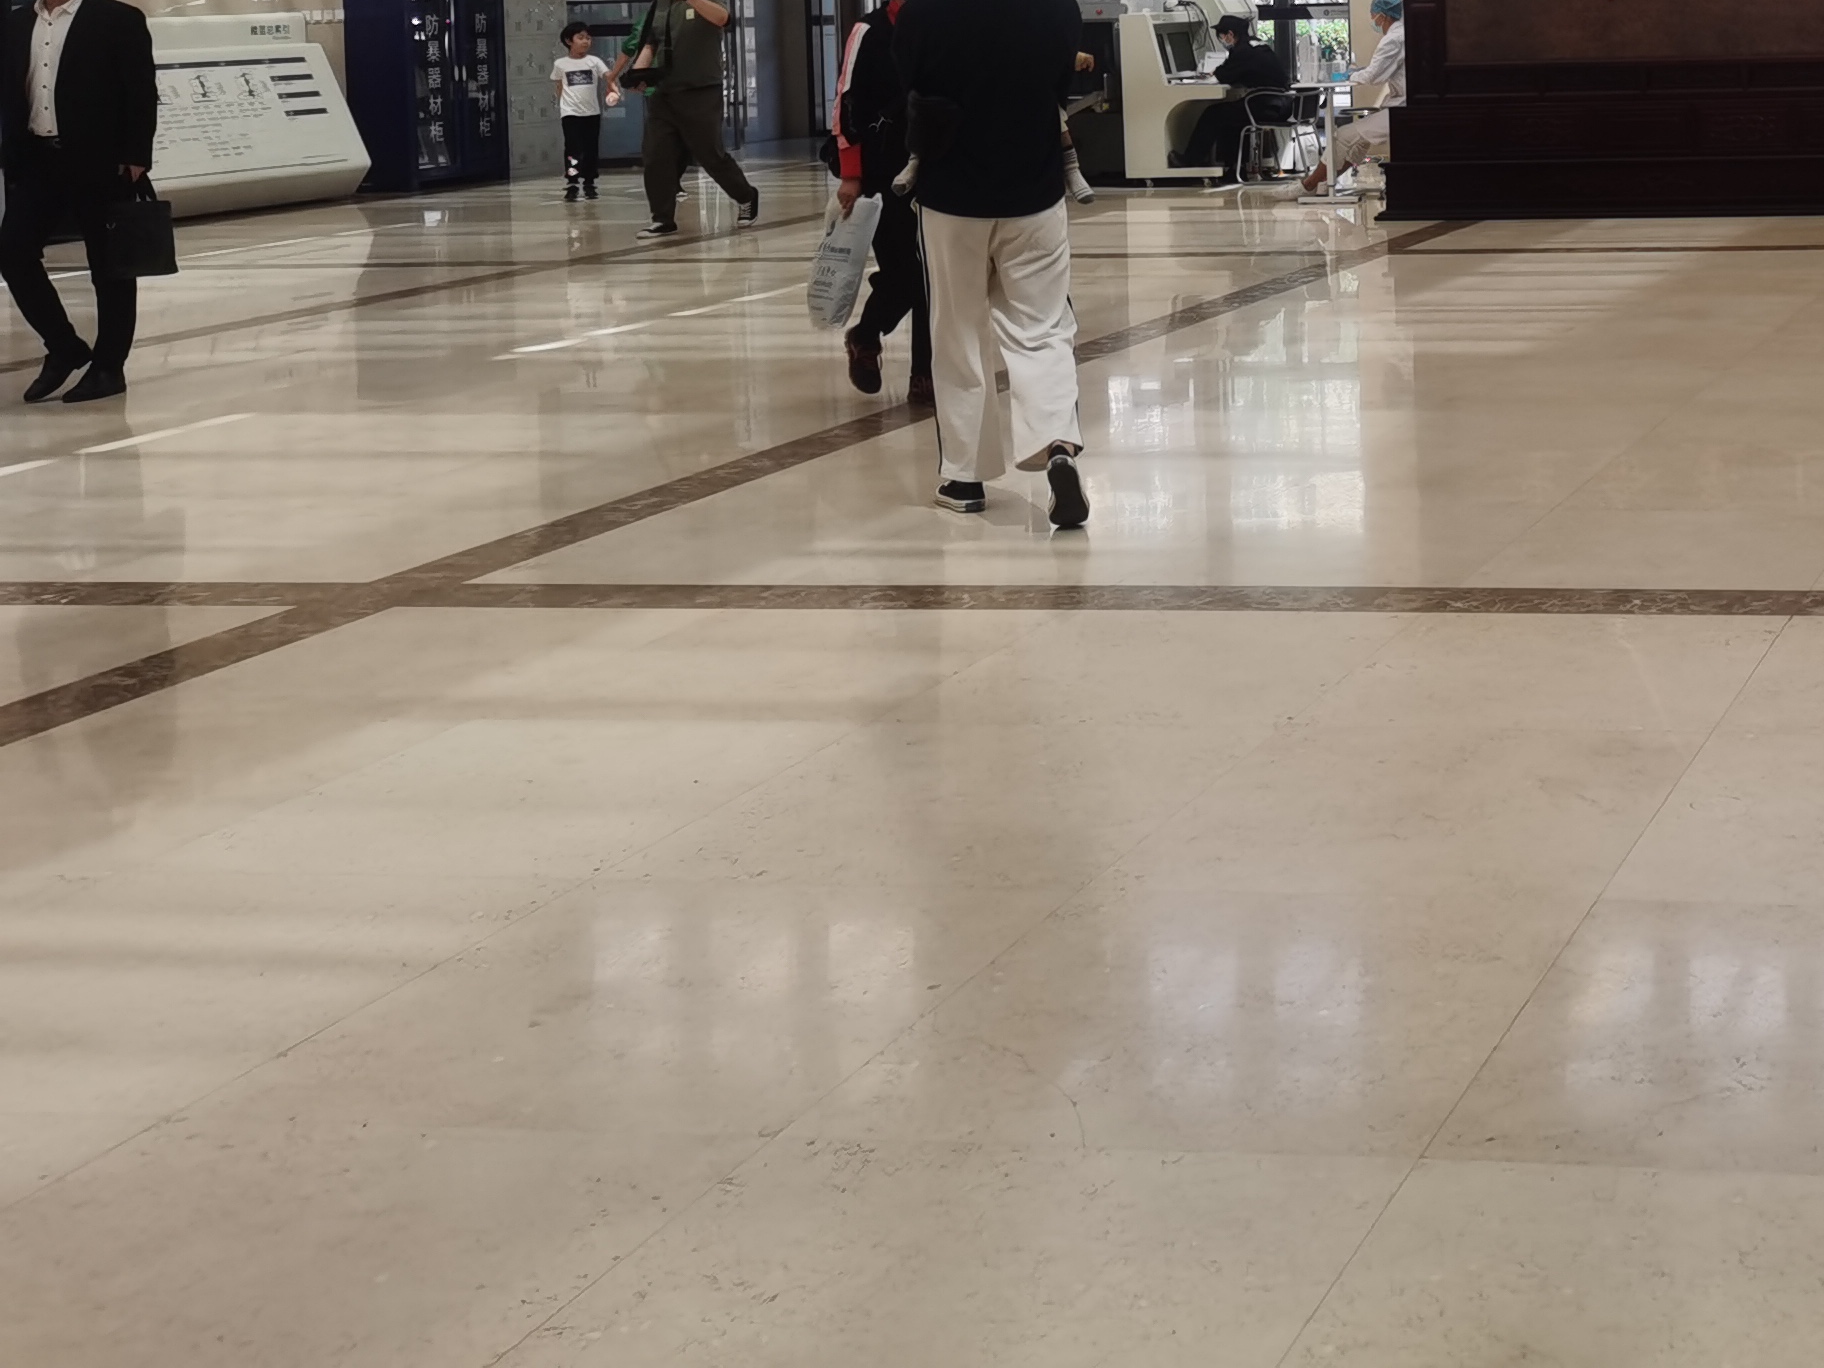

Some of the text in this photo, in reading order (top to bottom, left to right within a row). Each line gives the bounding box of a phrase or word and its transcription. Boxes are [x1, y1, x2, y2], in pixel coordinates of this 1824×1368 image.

[425, 13, 444, 144] 防暴器材柜
[475, 12, 492, 139] 防暴器材柜
